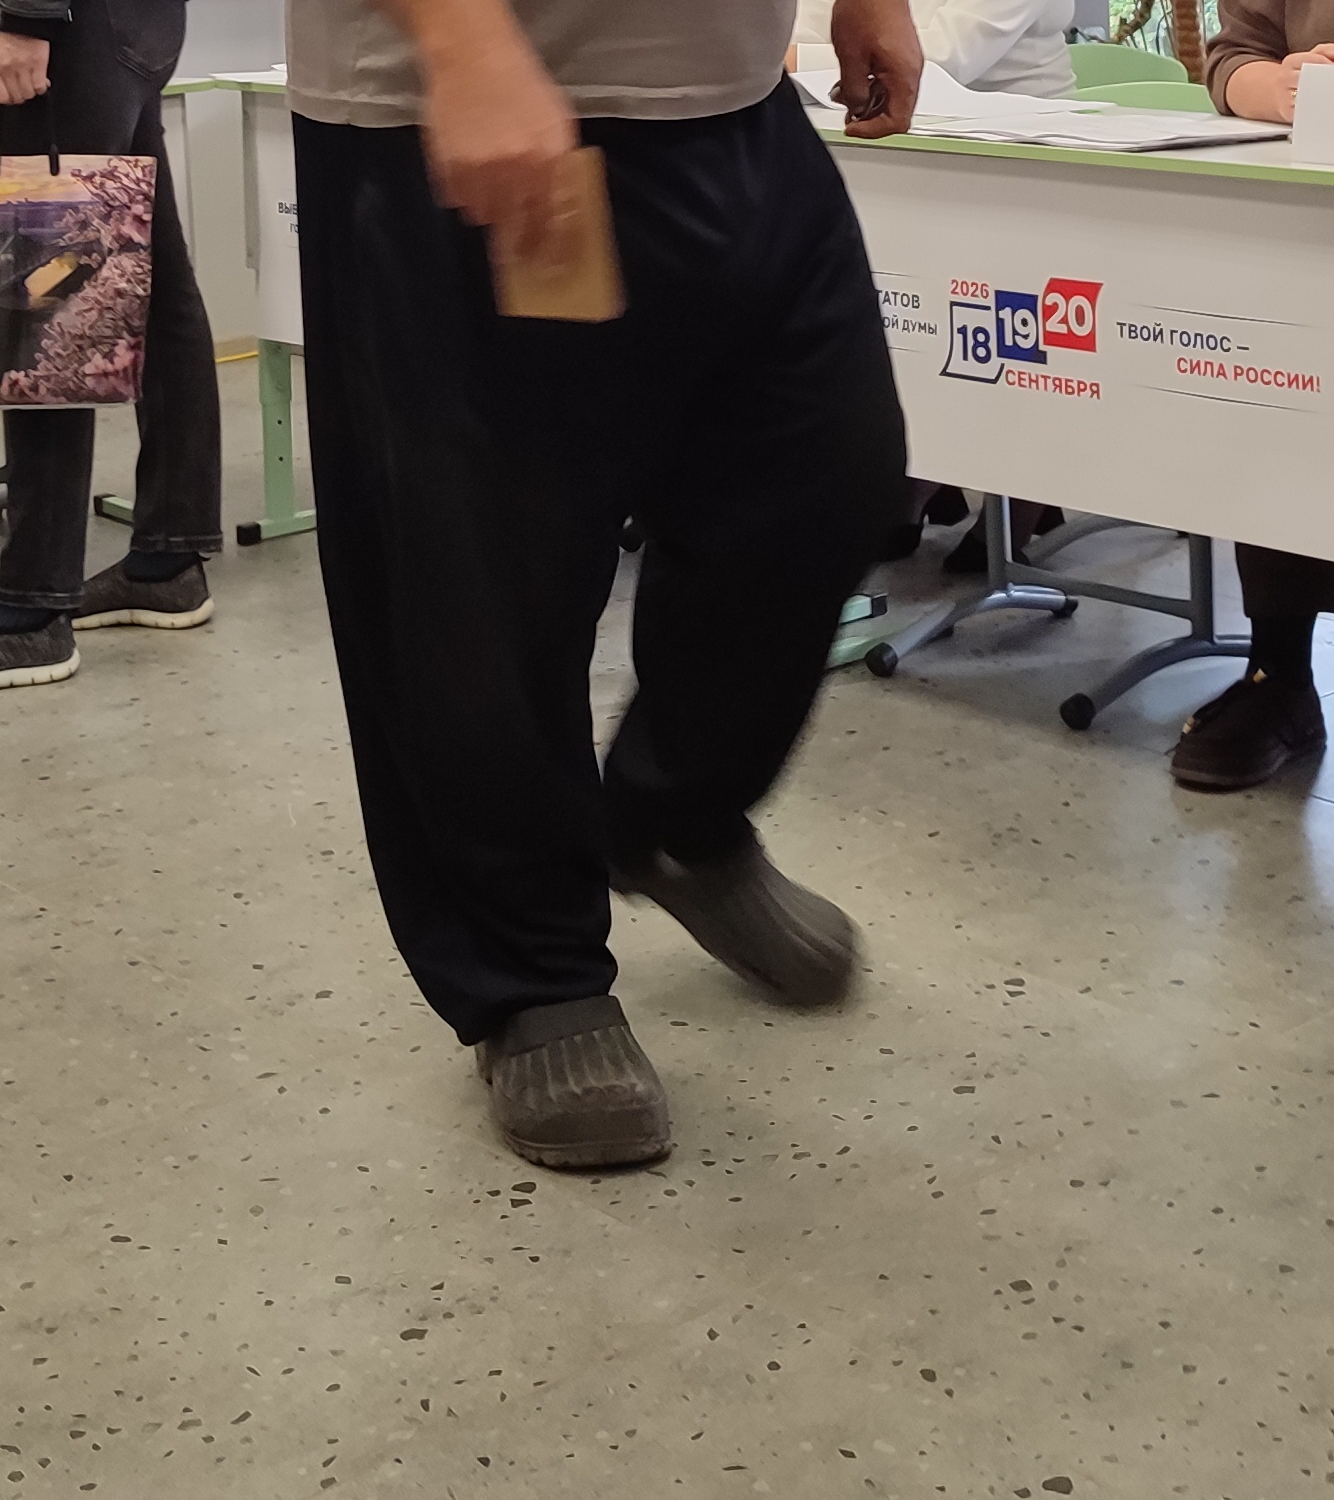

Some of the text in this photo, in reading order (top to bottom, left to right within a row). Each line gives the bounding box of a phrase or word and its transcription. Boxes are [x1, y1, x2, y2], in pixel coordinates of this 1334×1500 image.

[950, 279, 989, 299] 2026
[901, 320, 938, 336] ДУМЫ
[957, 292, 1094, 364] 18 19 20
[1116, 321, 1165, 344] ТВОЙ
[1169, 329, 1232, 353] ГОЛОС
[1004, 369, 1101, 400] СЕНТЯБРЯ
[1176, 357, 1321, 393] СИЛА РОССИИ!
